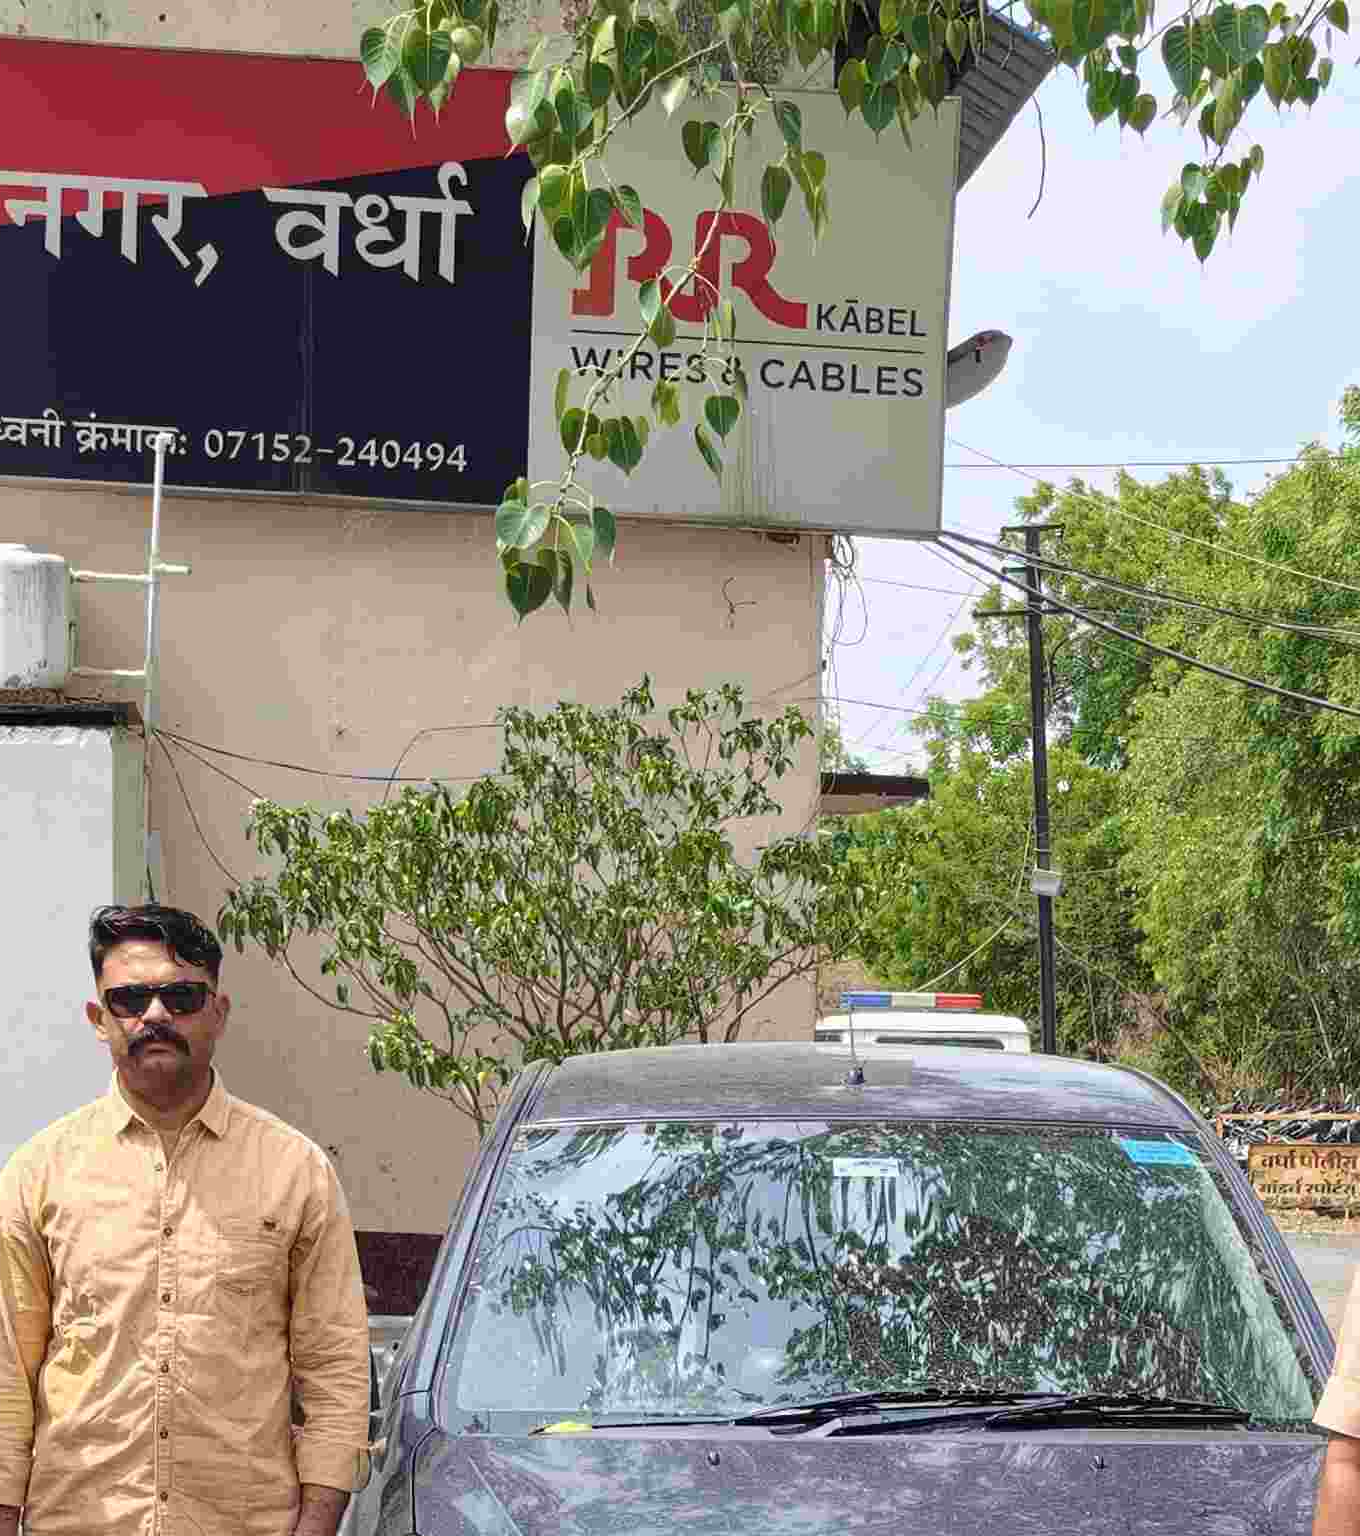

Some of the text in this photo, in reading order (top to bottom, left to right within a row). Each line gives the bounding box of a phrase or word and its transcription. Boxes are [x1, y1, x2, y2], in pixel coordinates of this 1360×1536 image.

[262, 161, 474, 284] वर्धा
[814, 299, 927, 337] KĀBEL
[570, 346, 707, 384] WIRES
[759, 358, 924, 398] CABLES
[203, 428, 468, 472] 07152-240494
